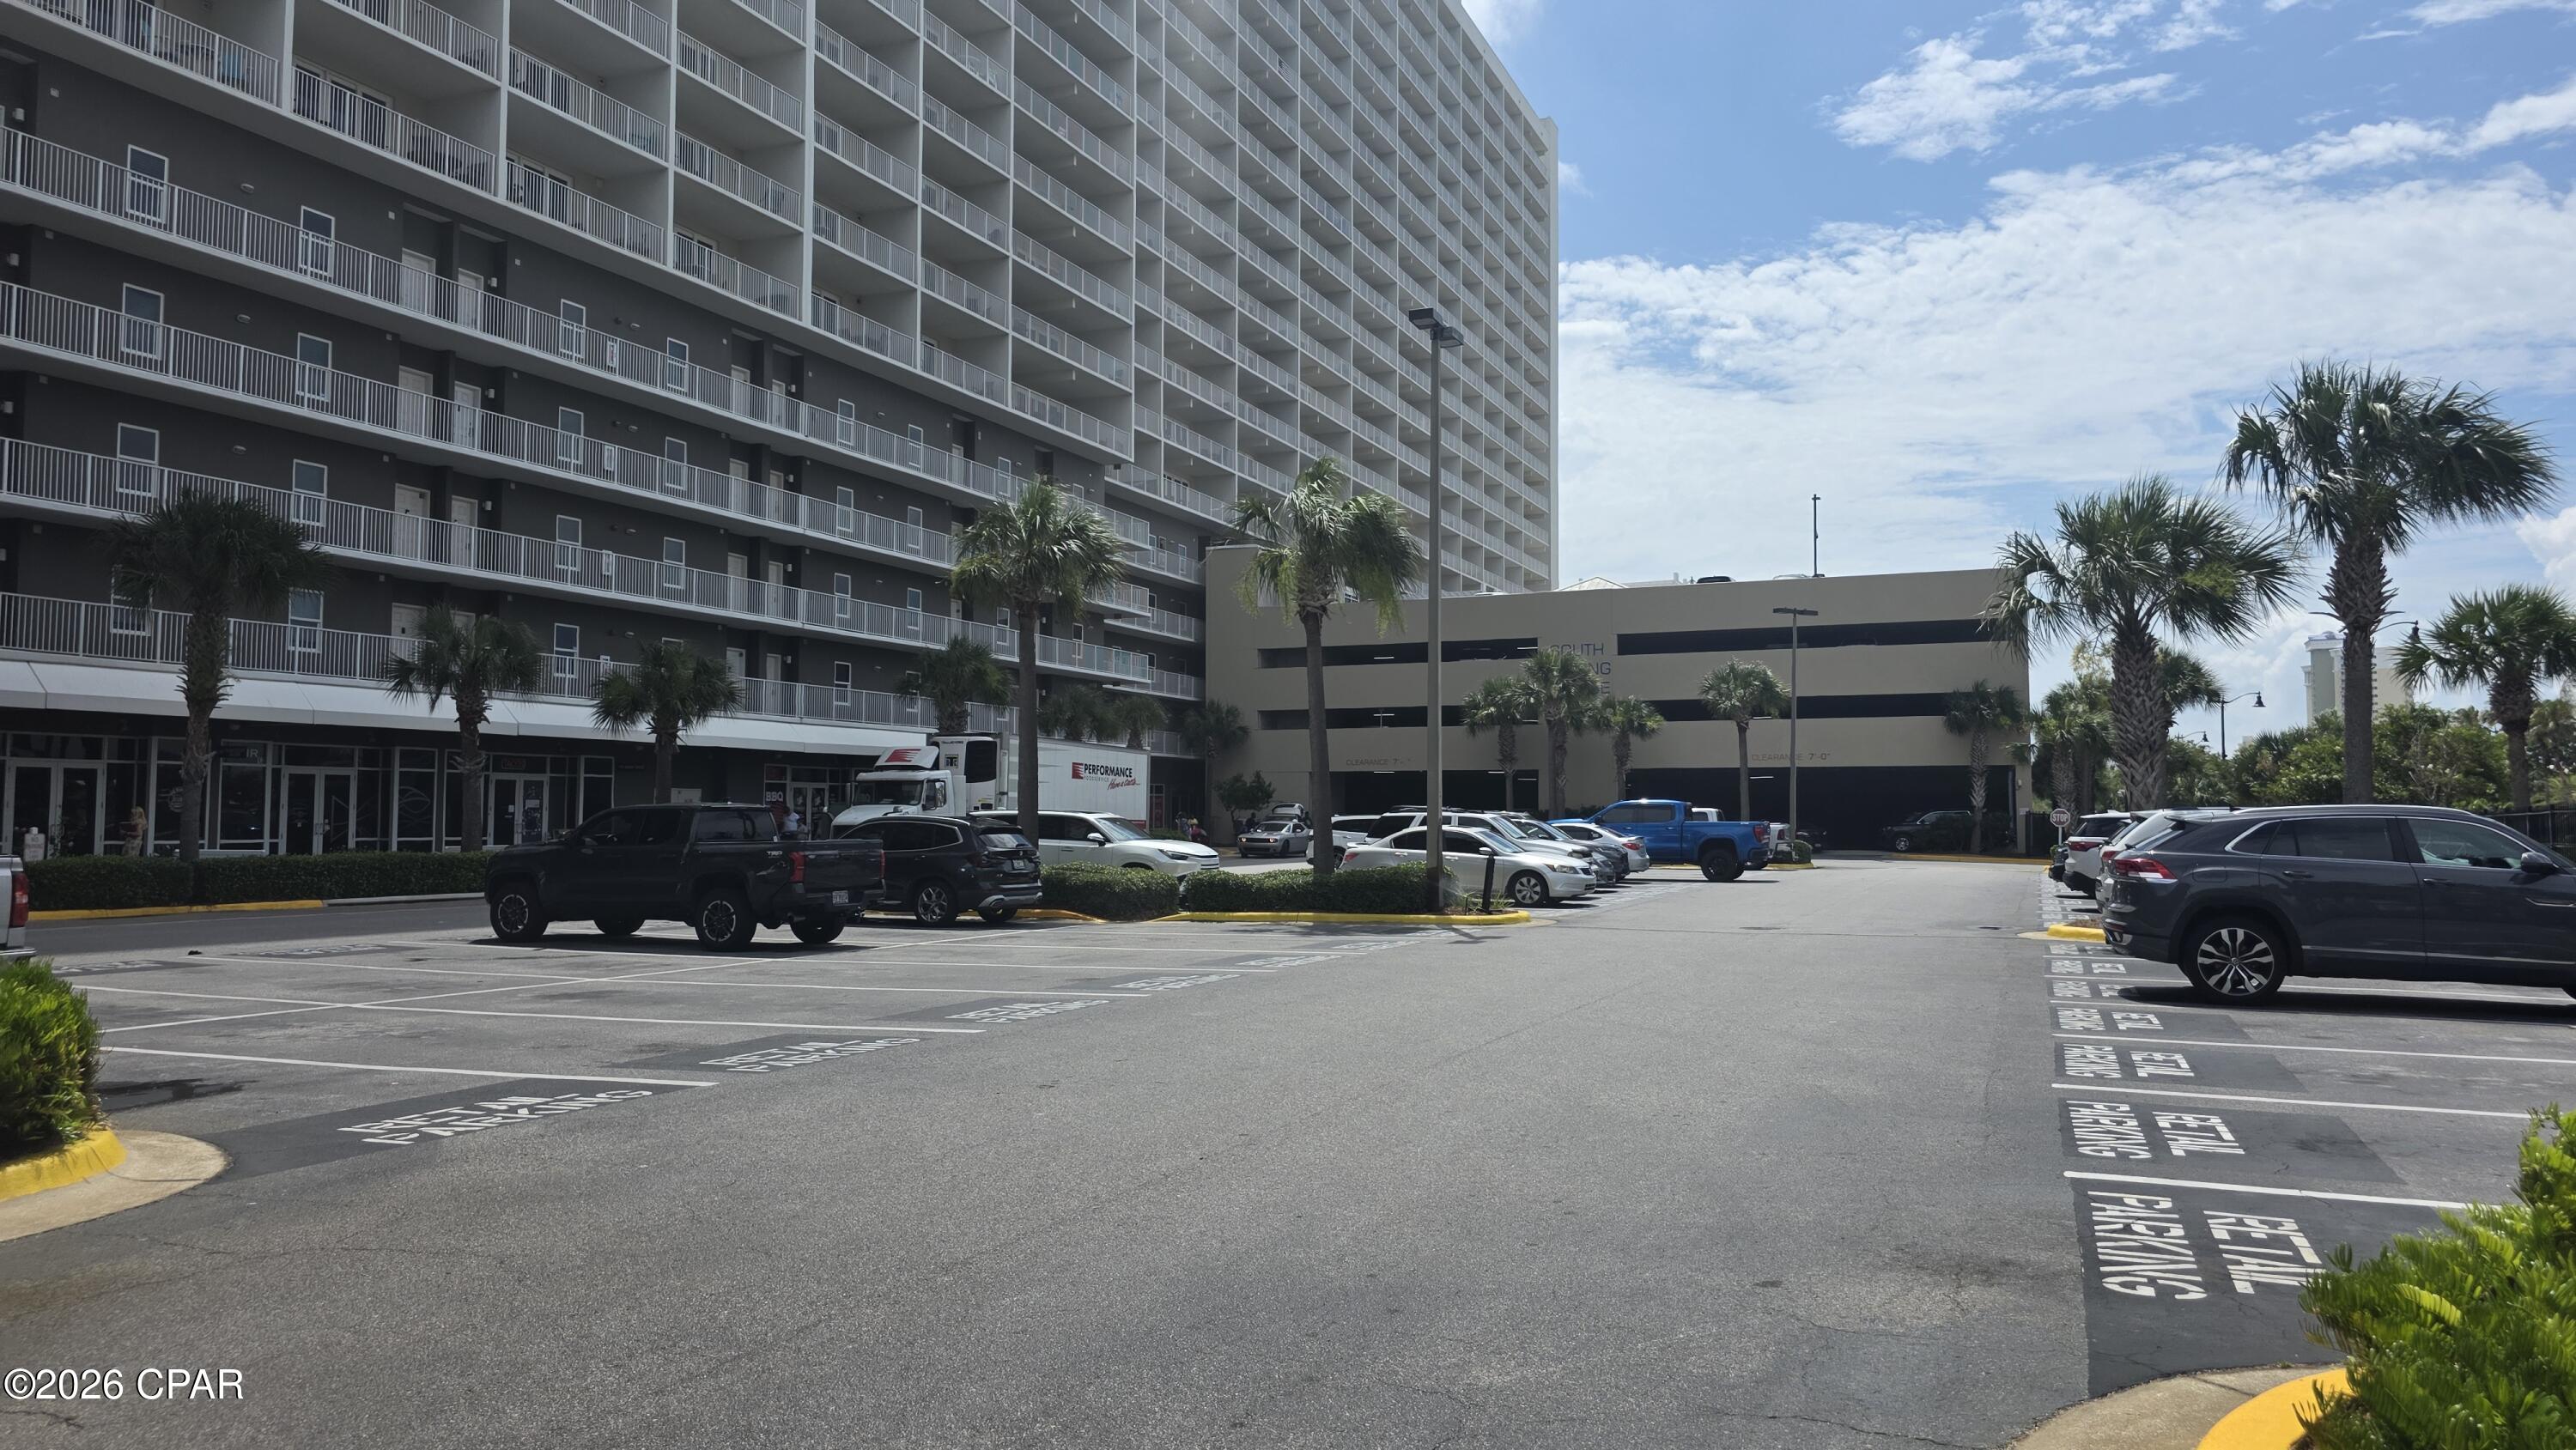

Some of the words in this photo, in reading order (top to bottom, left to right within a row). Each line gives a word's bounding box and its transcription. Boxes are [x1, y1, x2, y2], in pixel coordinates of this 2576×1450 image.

[1084, 763, 1133, 778] PERFORMANCE
[1752, 752, 1804, 761] CLEARANE
[766, 792, 783, 801] BBQ
[2052, 813, 2068, 822] STOP
[2063, 1043, 2122, 1078] PARKING
[2129, 1051, 2195, 1077] RETAIL
[337, 1093, 580, 1133] RETAIL
[361, 1090, 653, 1144] PARKING
[2066, 1100, 2153, 1159] PARKING
[2152, 1111, 2245, 1156] RETAIL
[2087, 1191, 2208, 1300] PARKING
[2203, 1210, 2329, 1295] RETAIL
